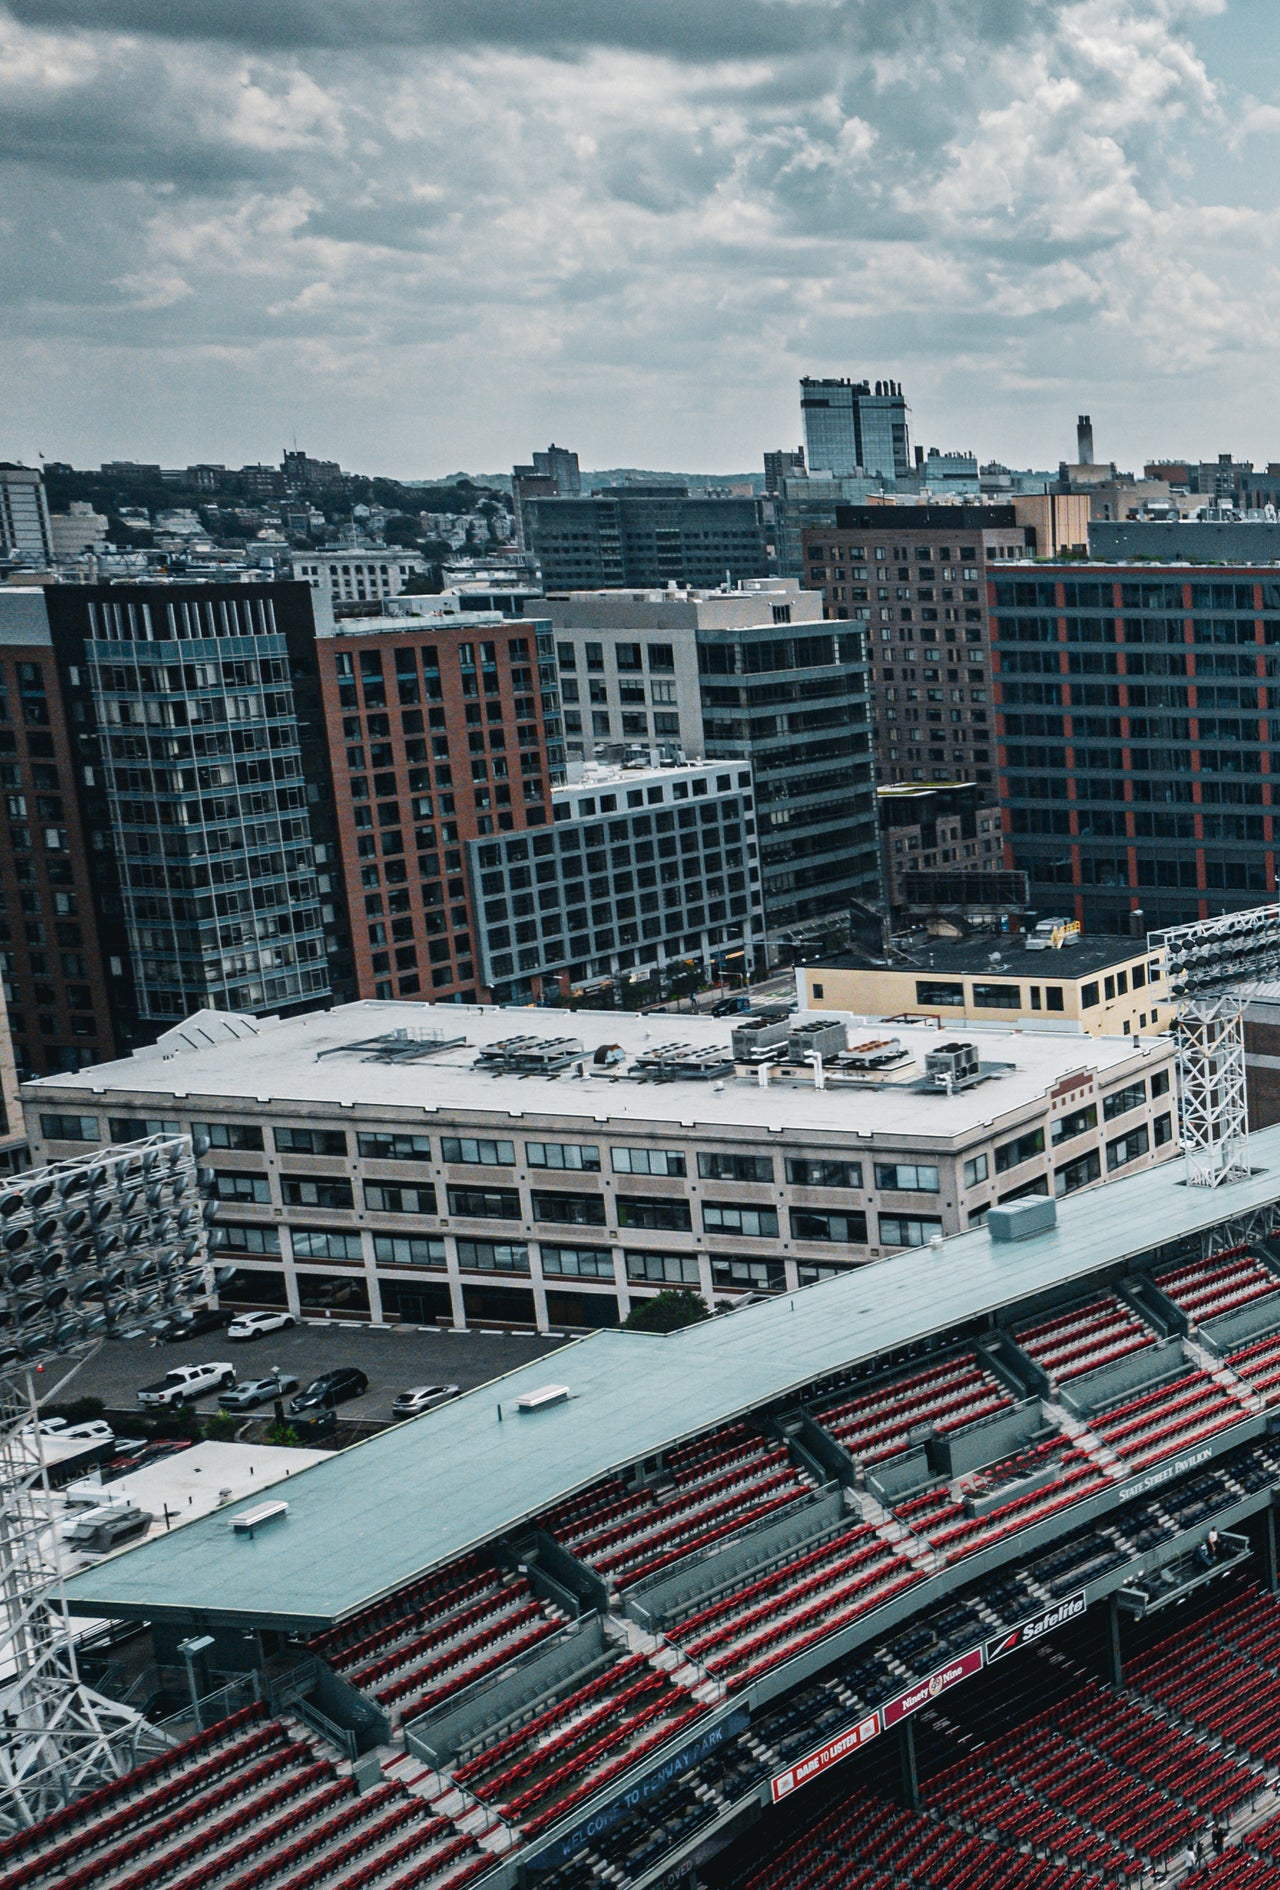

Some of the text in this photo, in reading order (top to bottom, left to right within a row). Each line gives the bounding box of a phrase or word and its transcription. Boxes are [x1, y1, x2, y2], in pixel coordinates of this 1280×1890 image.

[1119, 1449, 1212, 1500] STATE STREET PAVILION
[1022, 1599, 1083, 1641] Safelite
[902, 1667, 963, 1711] Ninety Nine
[796, 1756, 819, 1780] DARE
[820, 1750, 830, 1765] TO
[830, 1731, 857, 1758] LISTEN
[562, 1728, 723, 1856] WELCOME TO FENWAY PARK
